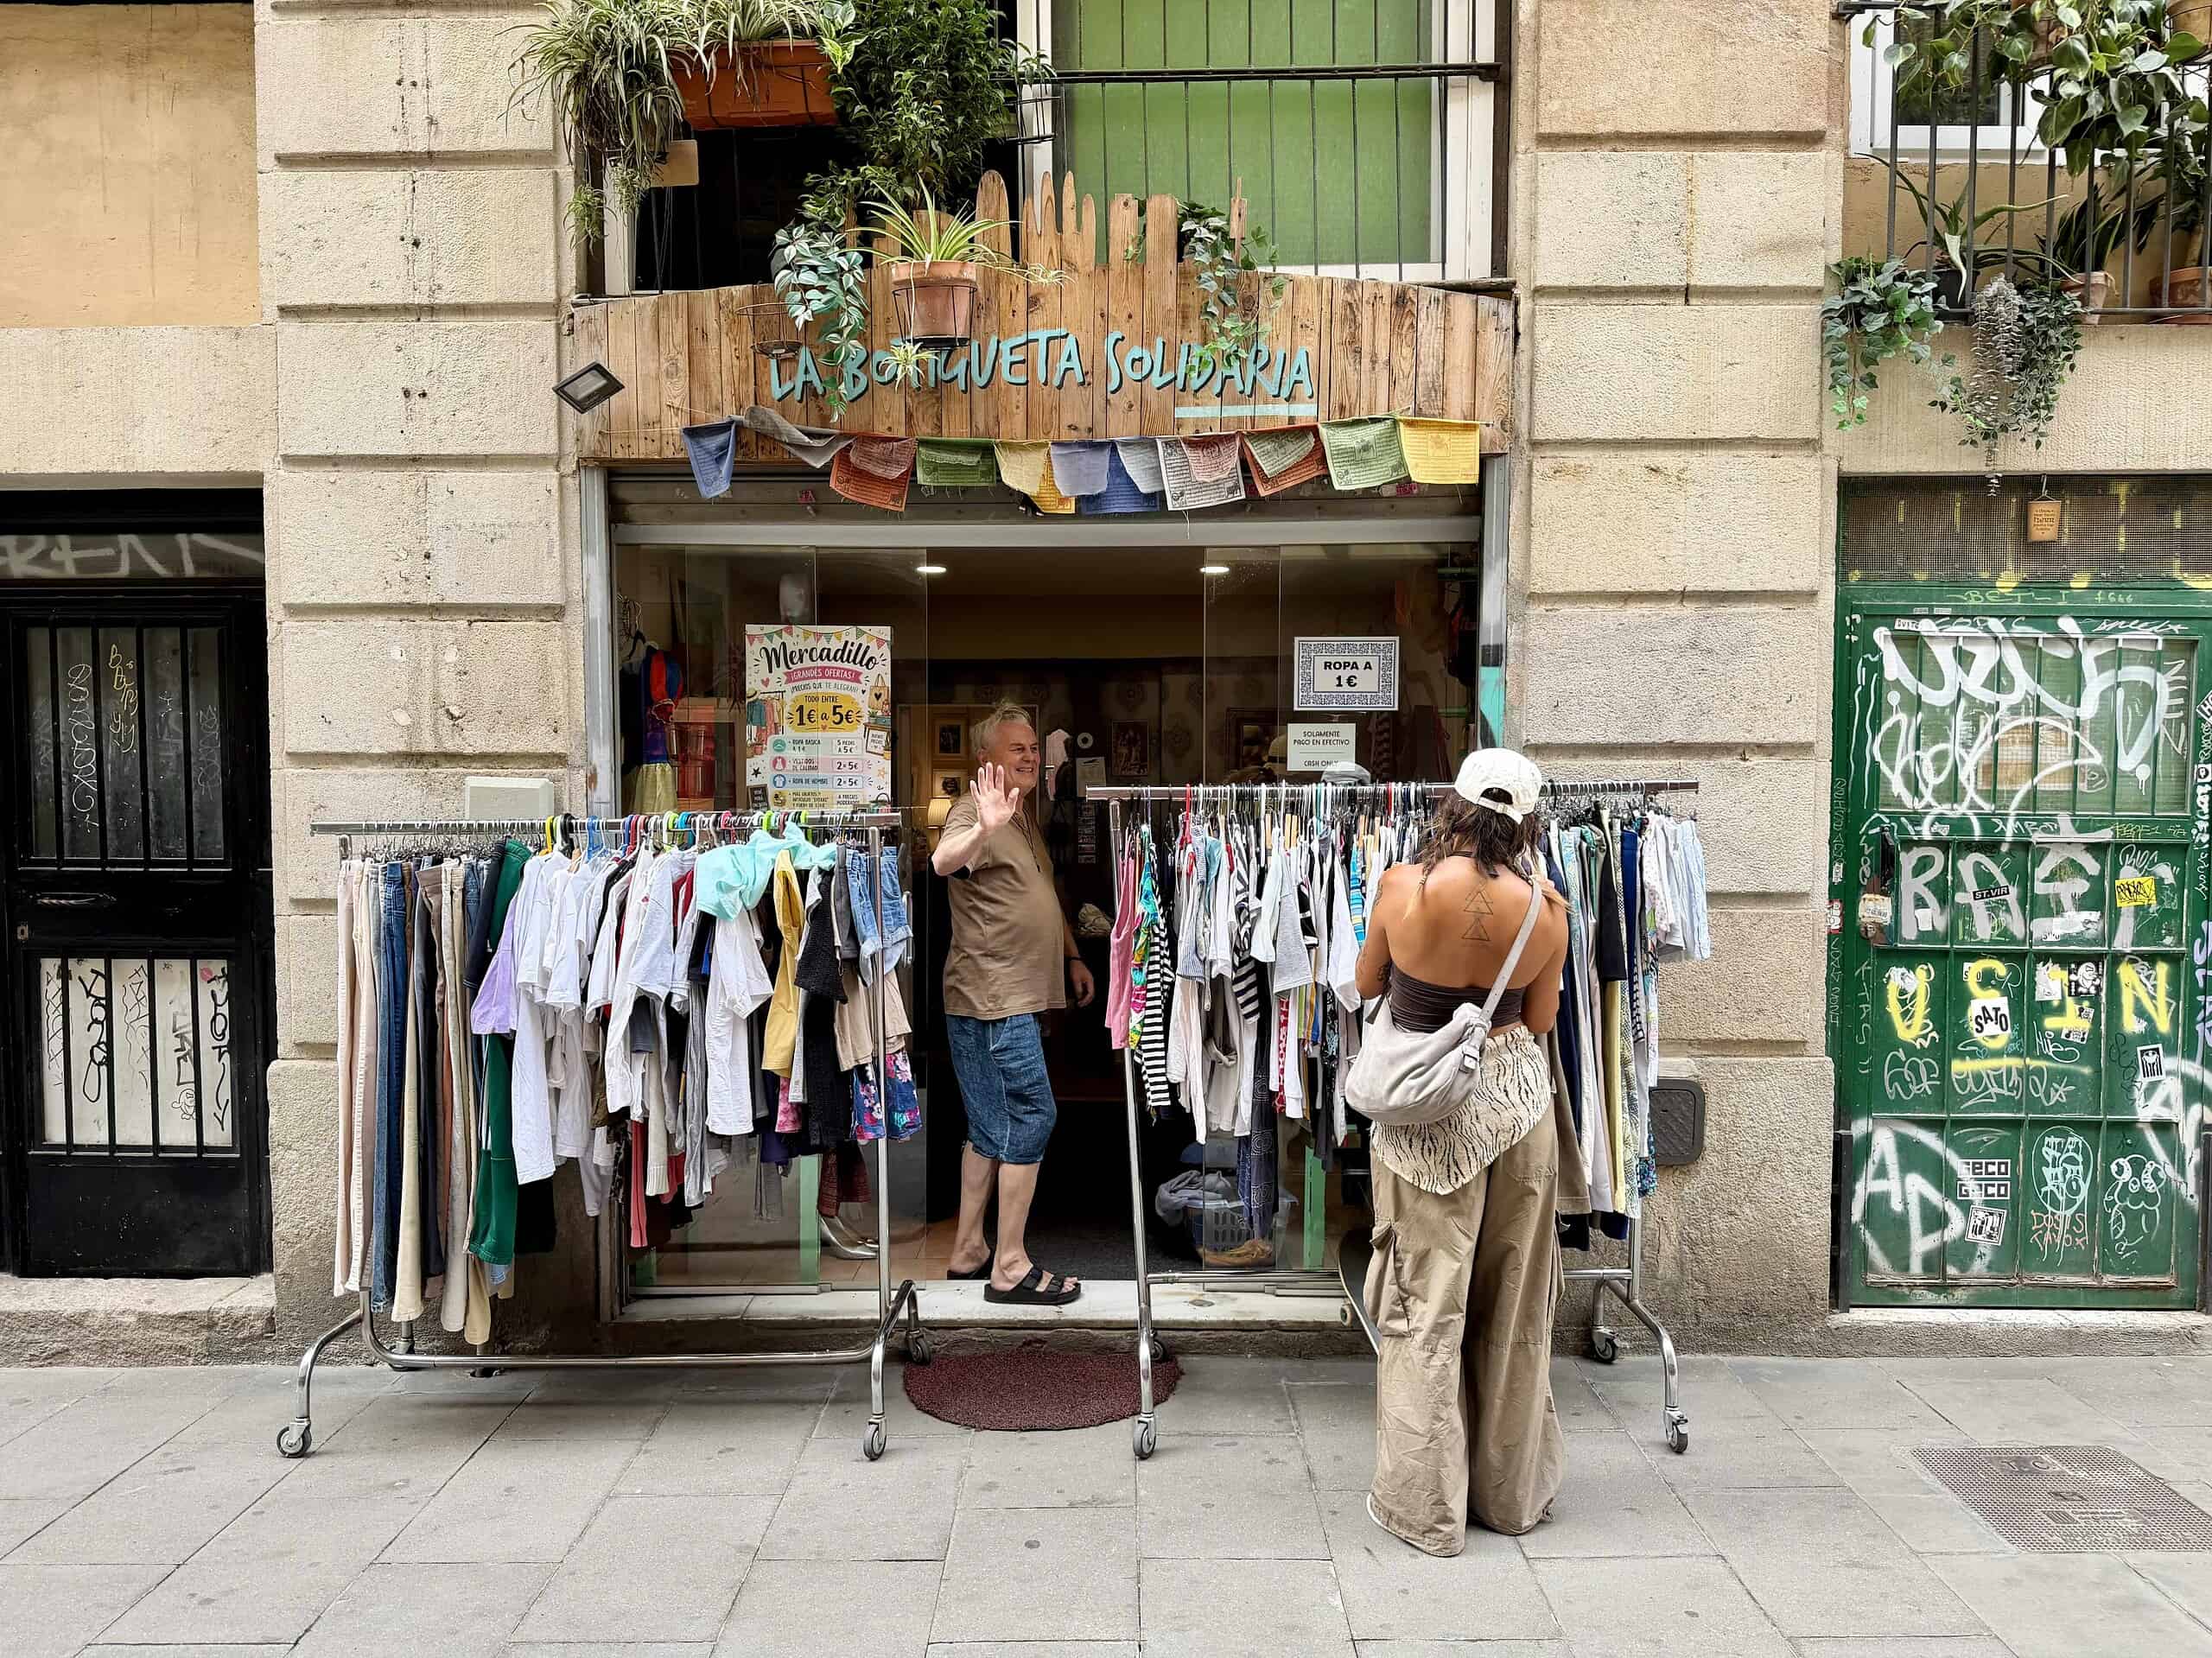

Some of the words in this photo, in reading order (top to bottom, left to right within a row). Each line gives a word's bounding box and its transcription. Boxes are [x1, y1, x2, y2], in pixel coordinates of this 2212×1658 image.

[769, 345, 826, 402] LA
[760, 640, 879, 673] Mercadillo
[1324, 661, 1358, 670] ROPA
[1363, 661, 1372, 670] A
[804, 695, 820, 704] TODO
[821, 695, 839, 704] ENTRE
[795, 704, 817, 727] 1€
[821, 712, 830, 721] a
[832, 704, 855, 726] 5€
[1974, 886, 2009, 900] ST.VIR
[1974, 1005, 2009, 1033] SATO
